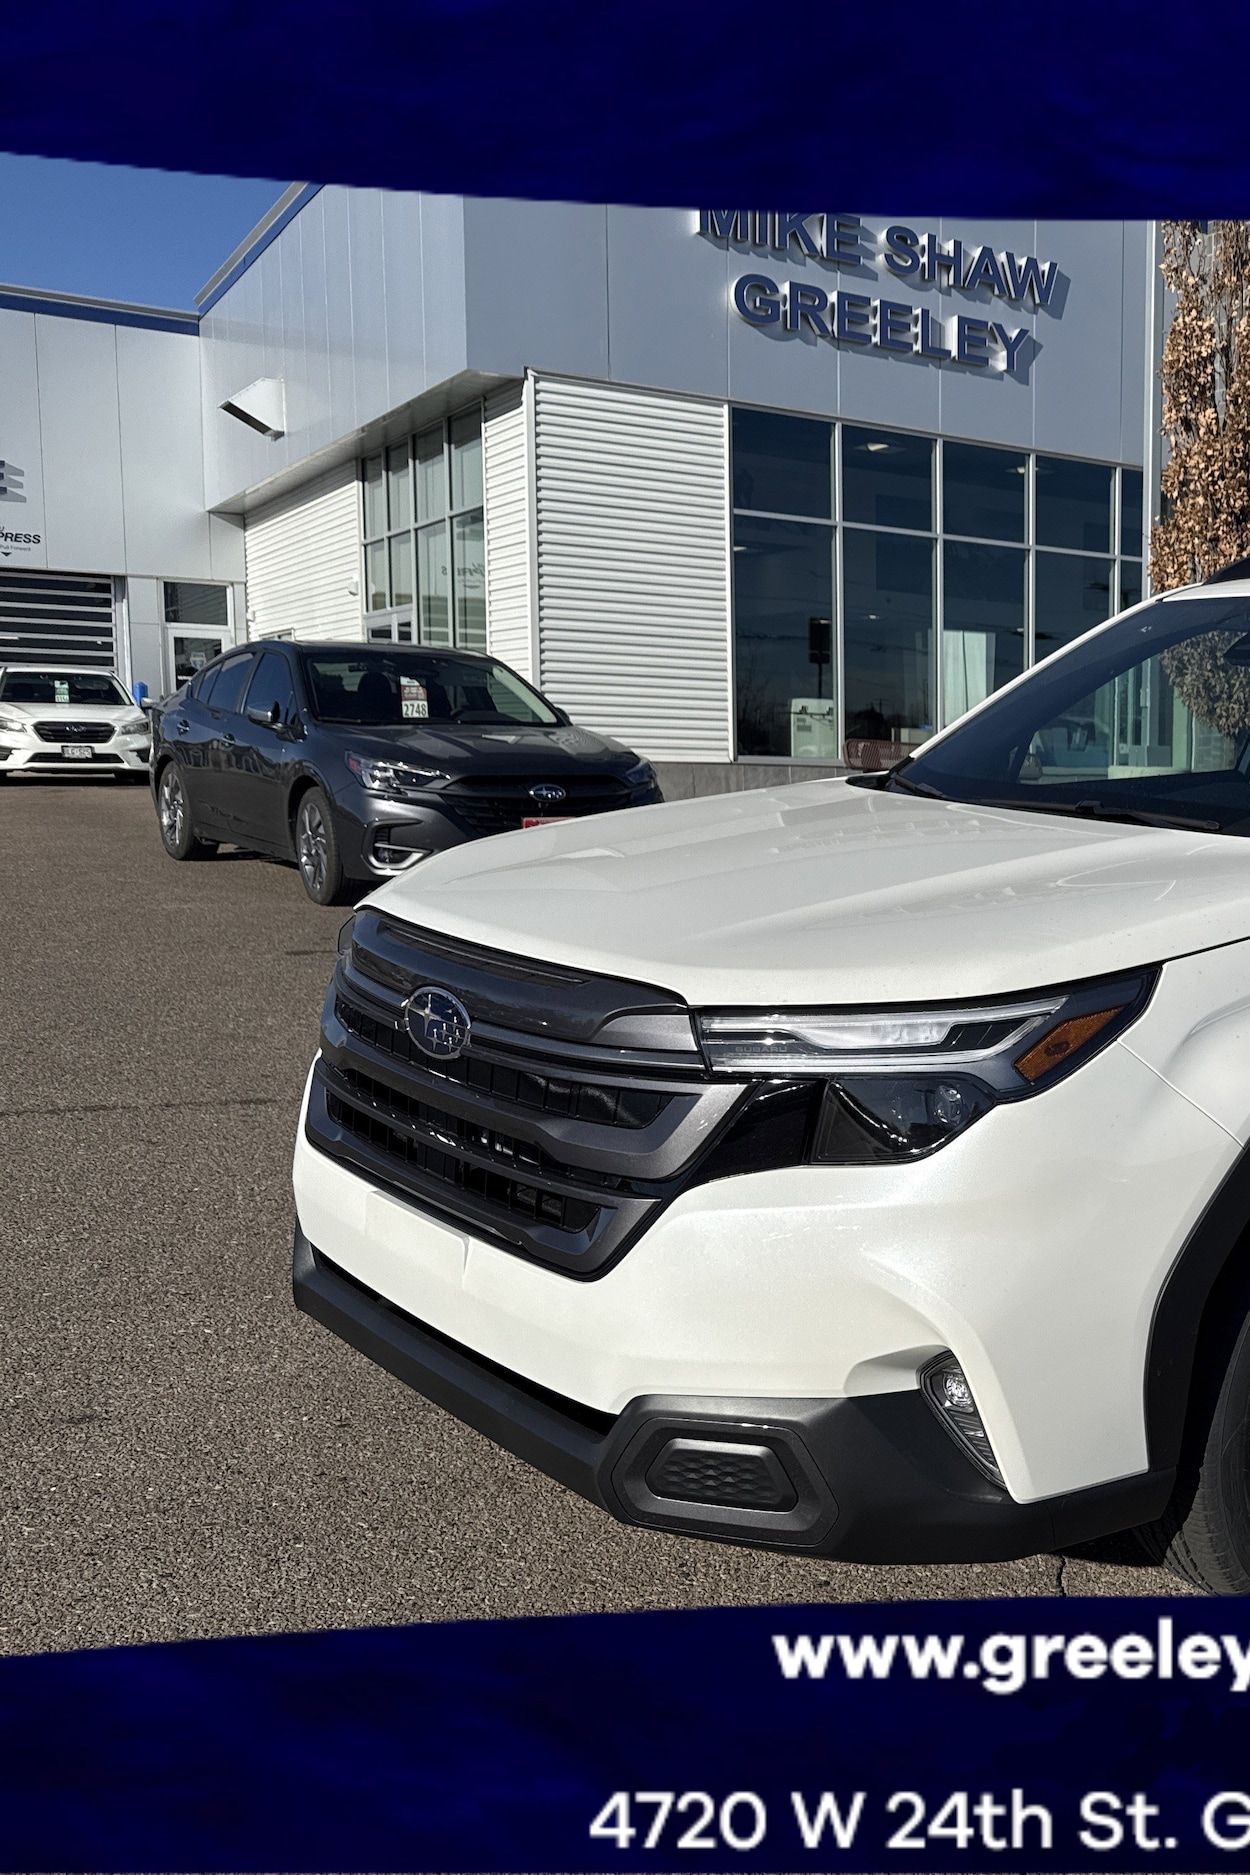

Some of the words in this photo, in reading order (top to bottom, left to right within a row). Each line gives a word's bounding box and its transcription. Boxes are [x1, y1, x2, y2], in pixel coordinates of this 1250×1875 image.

[883, 225, 1058, 305] SHAW
[732, 273, 1029, 371] GREELEY
[403, 703, 427, 716] 2748
